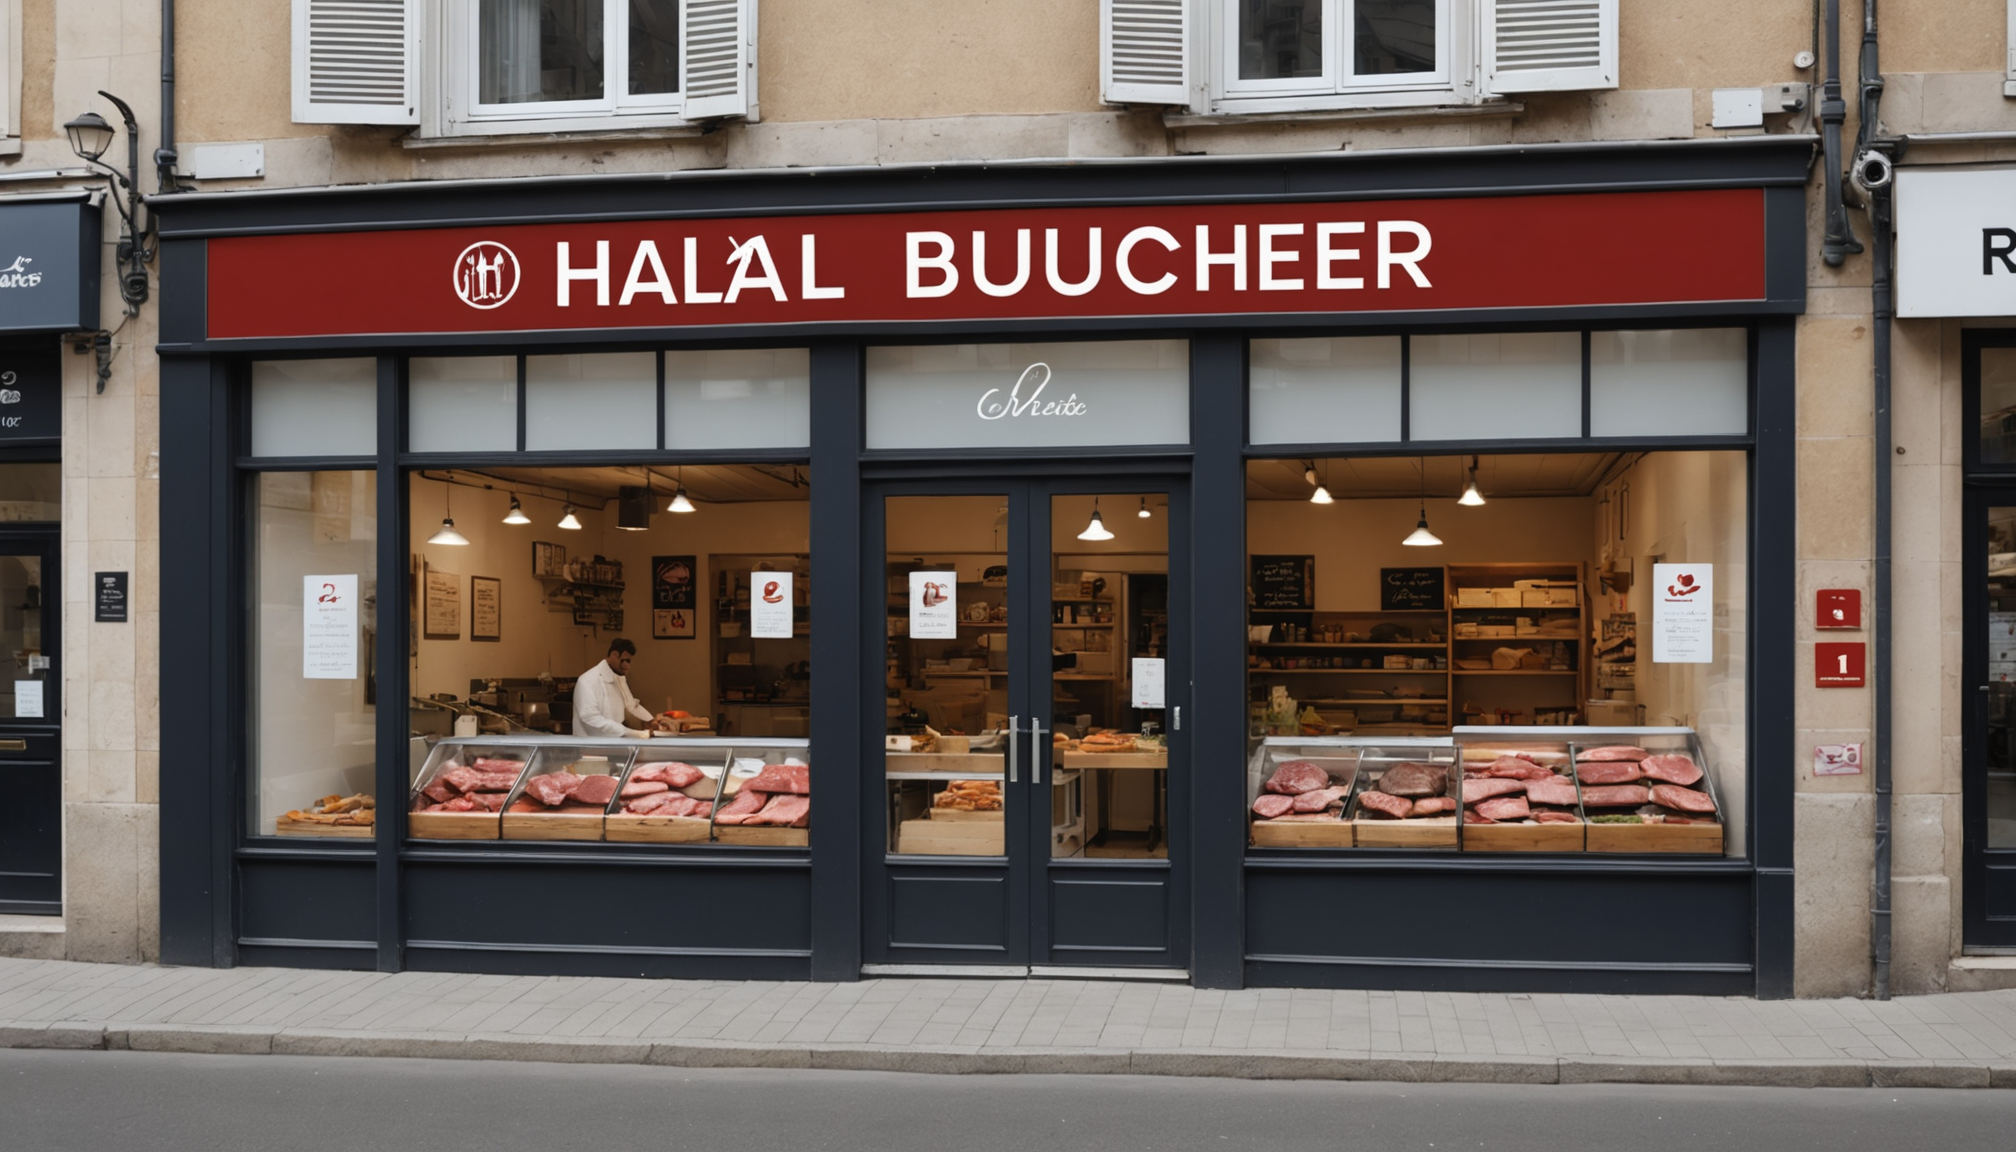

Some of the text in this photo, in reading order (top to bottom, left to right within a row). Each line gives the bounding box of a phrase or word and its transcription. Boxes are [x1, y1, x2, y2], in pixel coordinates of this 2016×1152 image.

[556, 220, 1433, 309] HALAL BUUCHEER
[1982, 227, 2016, 275] R
[1837, 654, 1848, 674] 1
